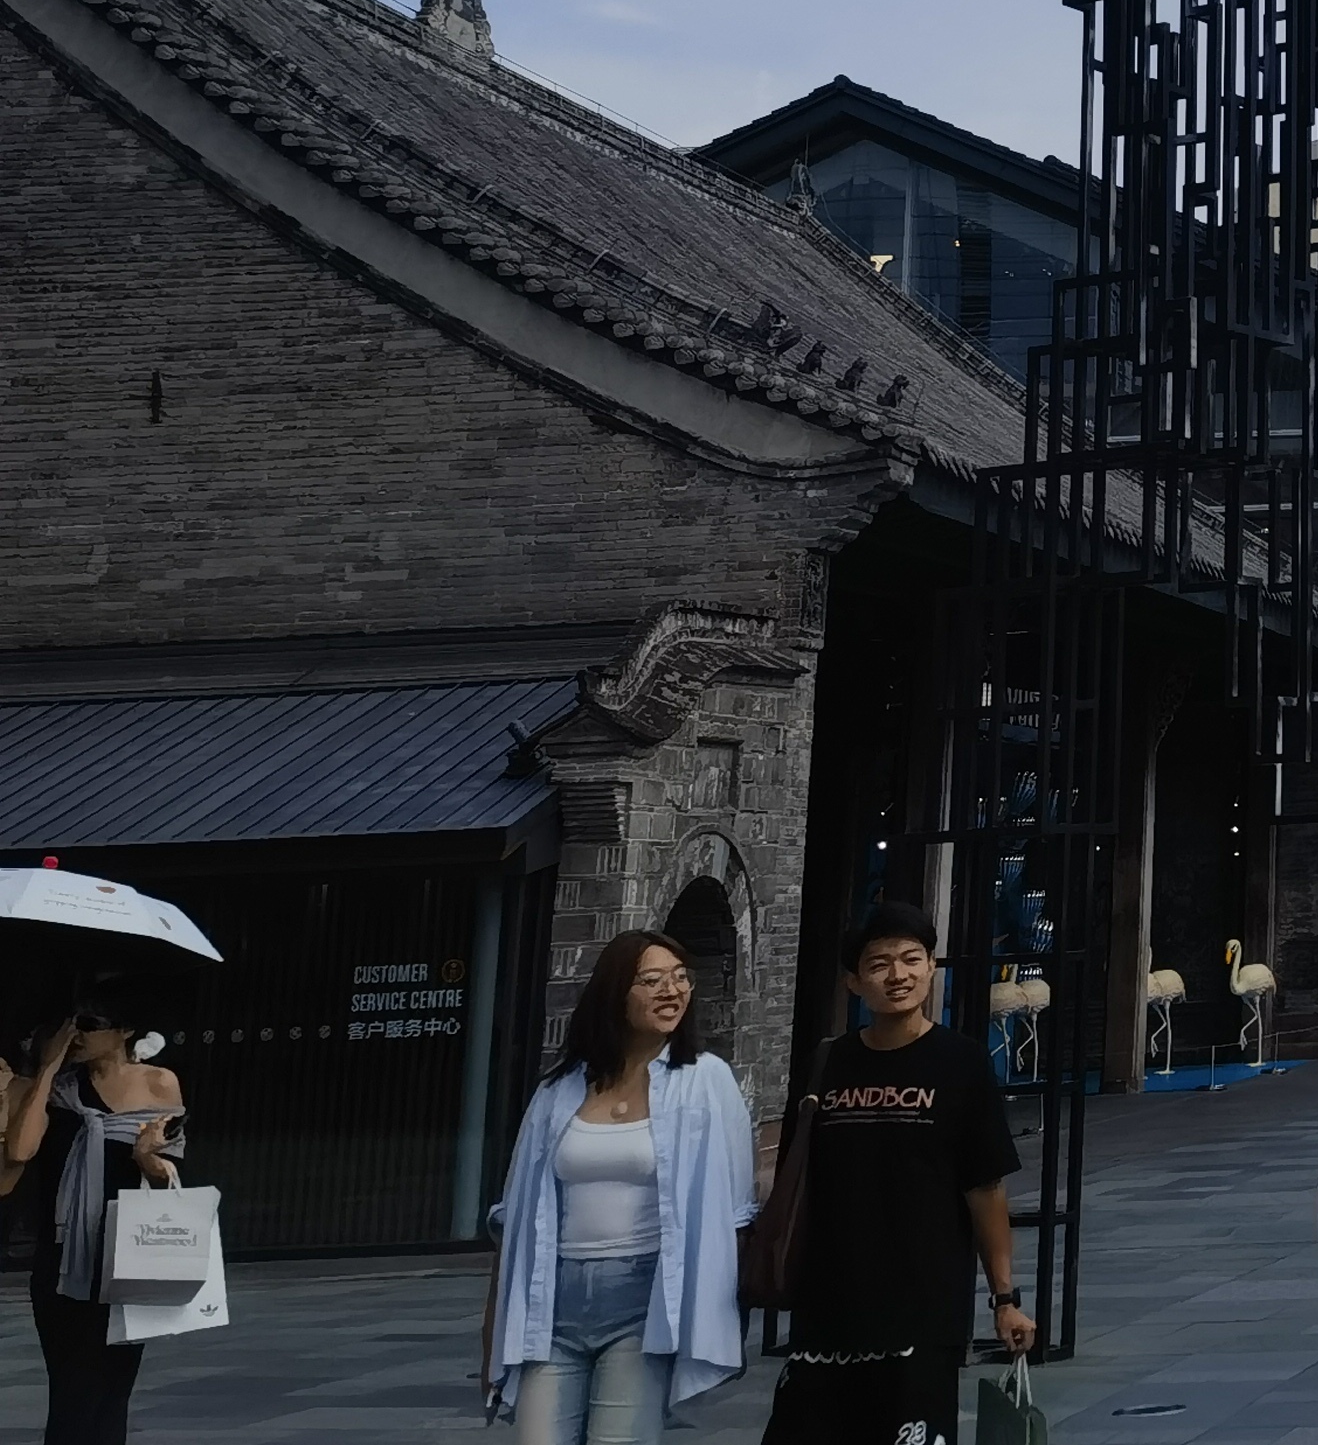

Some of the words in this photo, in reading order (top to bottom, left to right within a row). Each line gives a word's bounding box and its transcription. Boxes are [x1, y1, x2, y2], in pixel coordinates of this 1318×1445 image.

[353, 963, 429, 985] CUSTOMER
[350, 991, 409, 1013] SERVICE
[410, 989, 464, 1009] CENTRE
[347, 1017, 461, 1041] 客户服务中心
